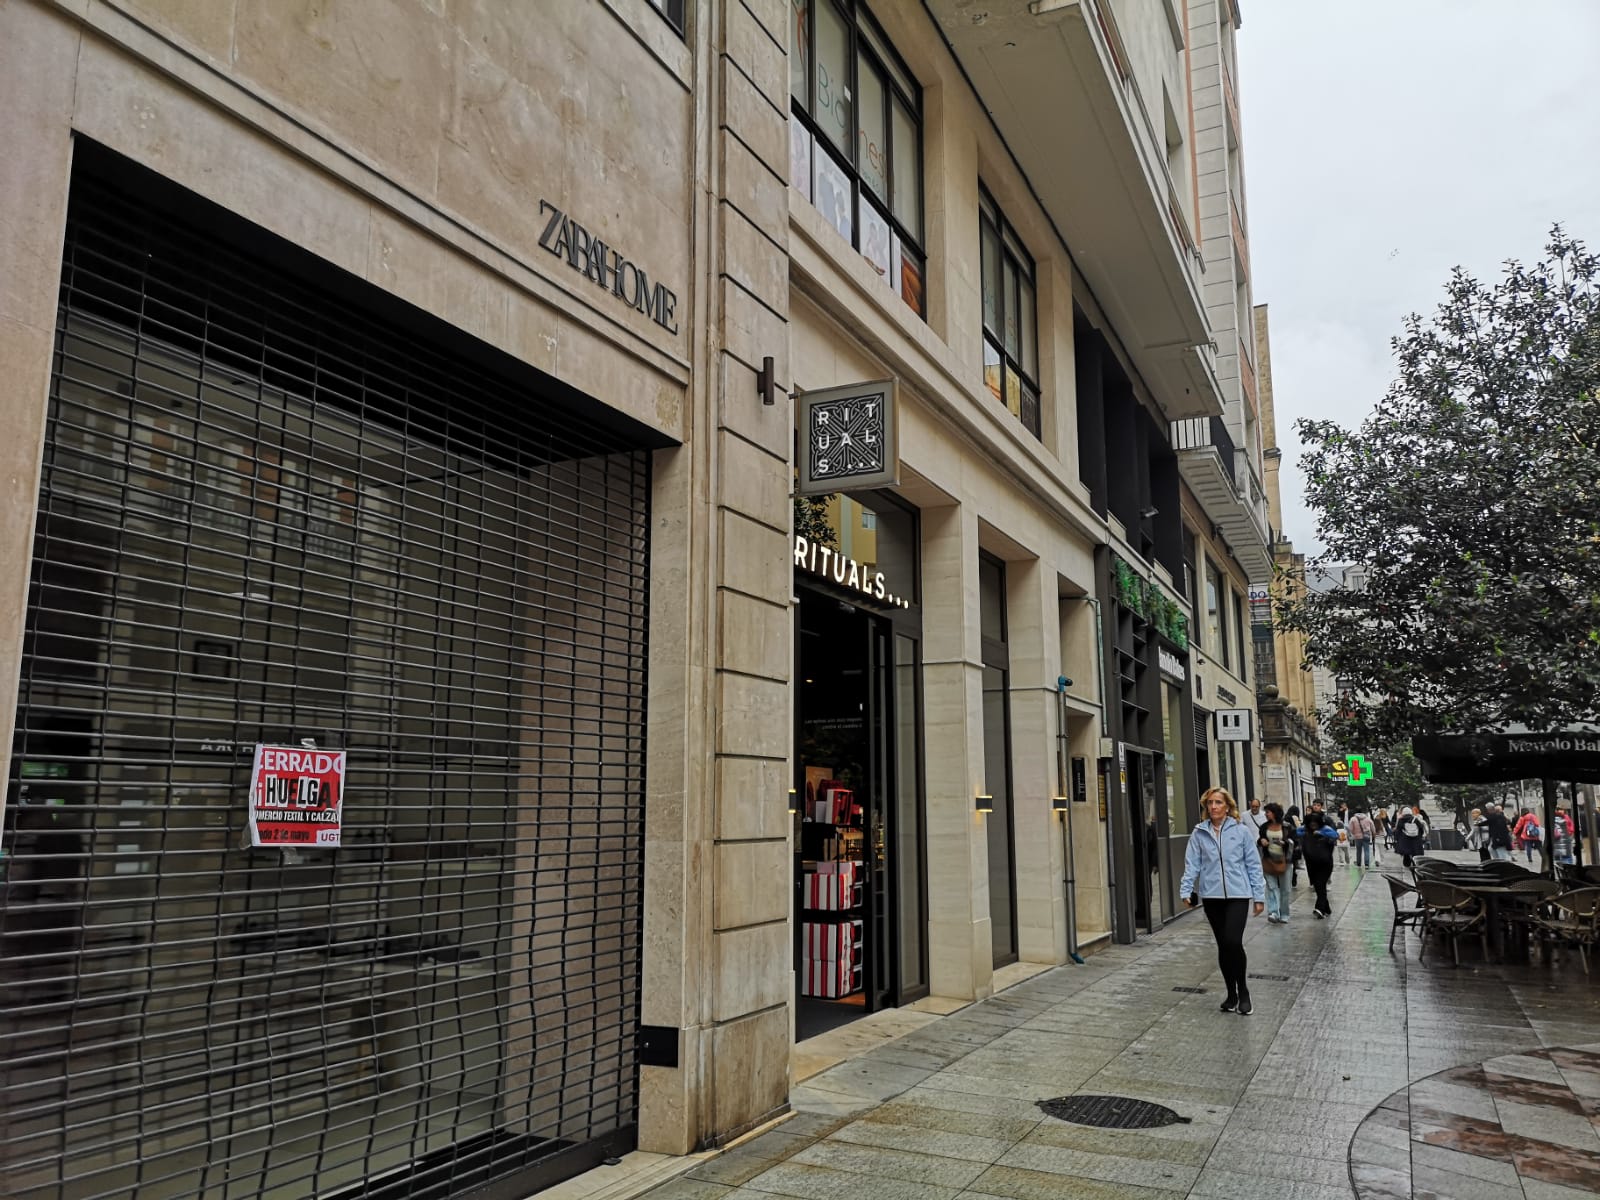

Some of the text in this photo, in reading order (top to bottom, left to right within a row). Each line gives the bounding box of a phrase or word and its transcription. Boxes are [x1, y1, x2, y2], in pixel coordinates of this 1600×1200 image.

[259, 751, 341, 775] ERRAD
[283, 811, 304, 822] TEXTIL
[311, 812, 339, 823] CALZA
[321, 833, 340, 842] UGT
